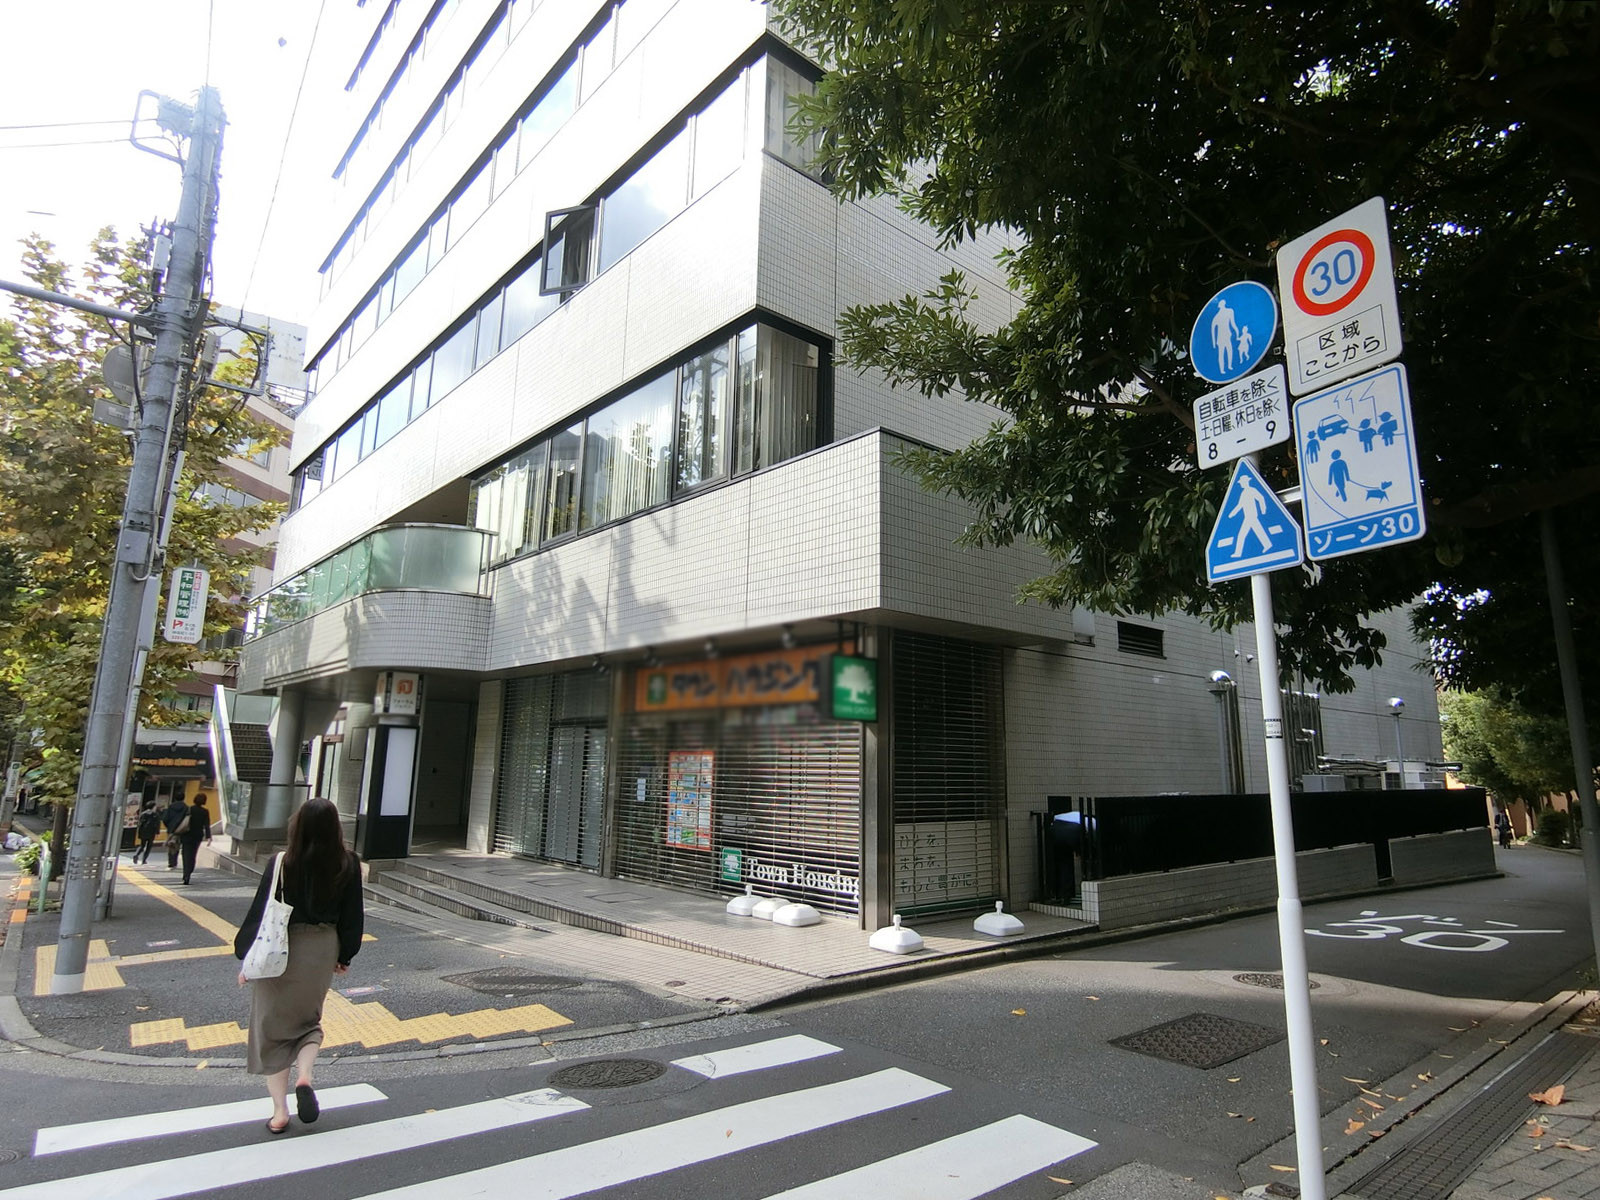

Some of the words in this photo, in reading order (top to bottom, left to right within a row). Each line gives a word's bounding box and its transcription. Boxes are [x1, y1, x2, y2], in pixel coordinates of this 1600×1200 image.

[1310, 249, 1356, 296] 30
[1304, 334, 1381, 377] ここから
[1318, 321, 1361, 351] 区域
[1198, 378, 1279, 420] 自転車を除く
[1208, 443, 1218, 460] 8
[1265, 421, 1276, 440] 9
[1314, 514, 1414, 553] ゾーン30
[747, 858, 788, 884] Town
